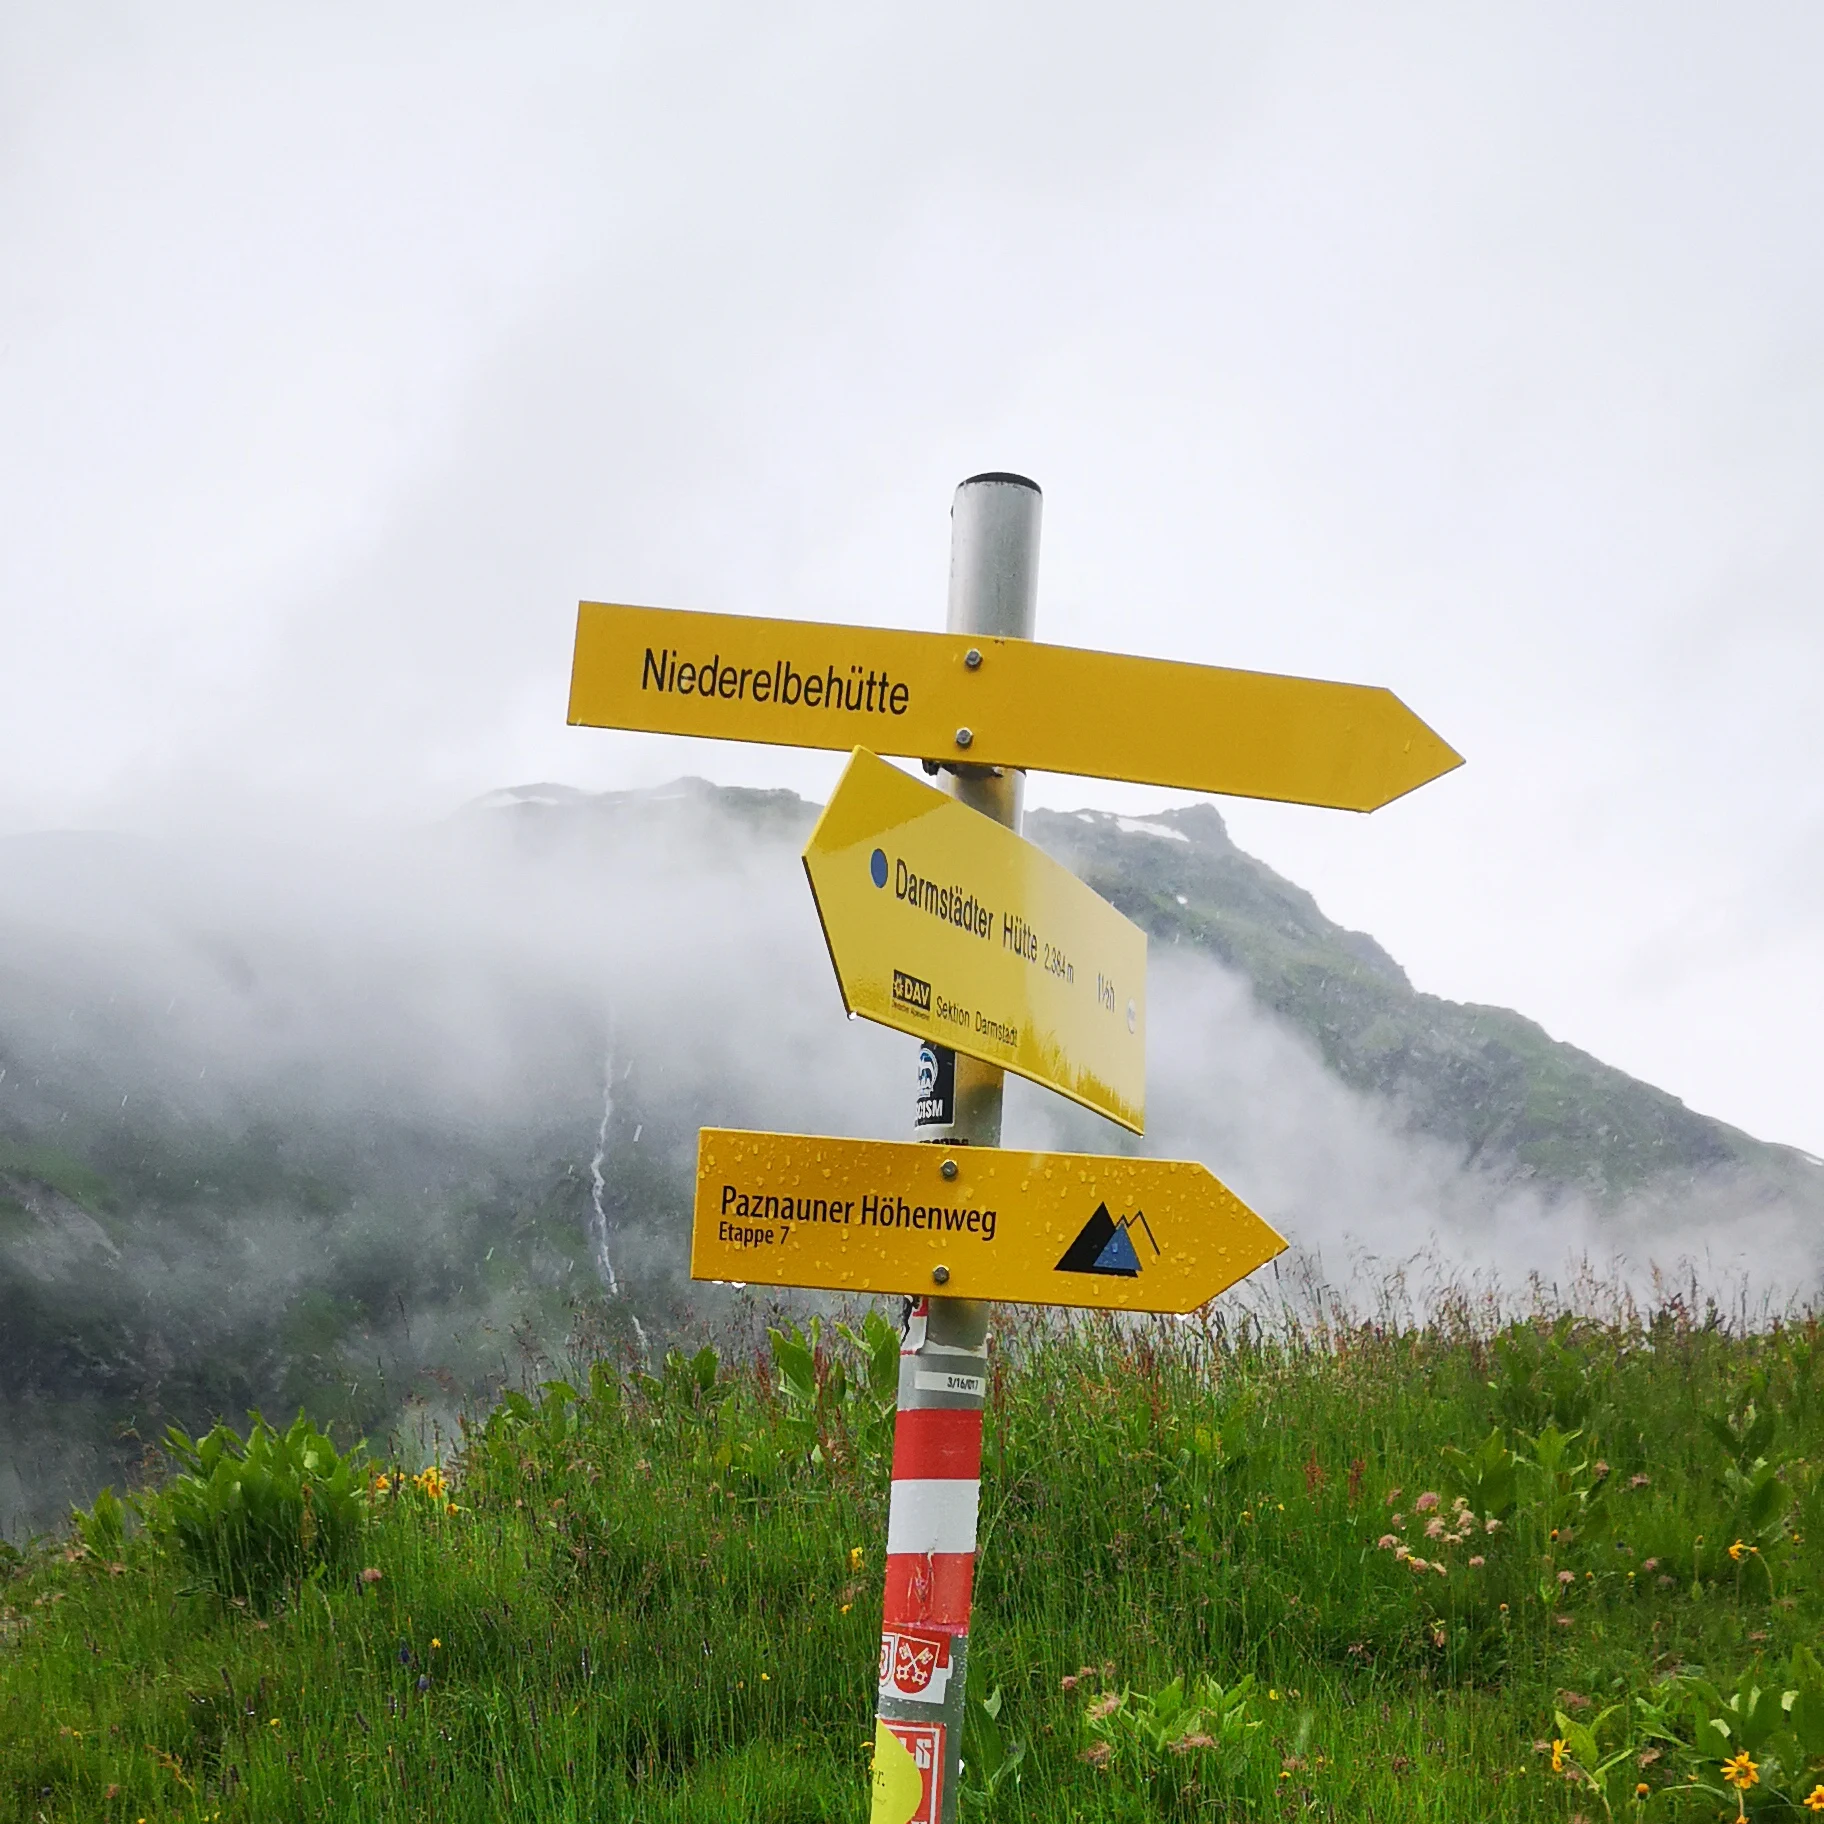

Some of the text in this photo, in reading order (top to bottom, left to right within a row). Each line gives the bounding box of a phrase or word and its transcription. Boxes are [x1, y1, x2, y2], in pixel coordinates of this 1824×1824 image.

[642, 648, 909, 715] Niederelbehütte
[896, 858, 994, 940] Darmstädter
[1003, 911, 1037, 963] Hütte
[904, 978, 930, 1006] DAV
[936, 996, 970, 1028] Sektion
[976, 1010, 1018, 1047] Darmstadt
[719, 1221, 790, 1247] Etappe 7
[721, 1186, 997, 1241] Paznauner Höhenweg
